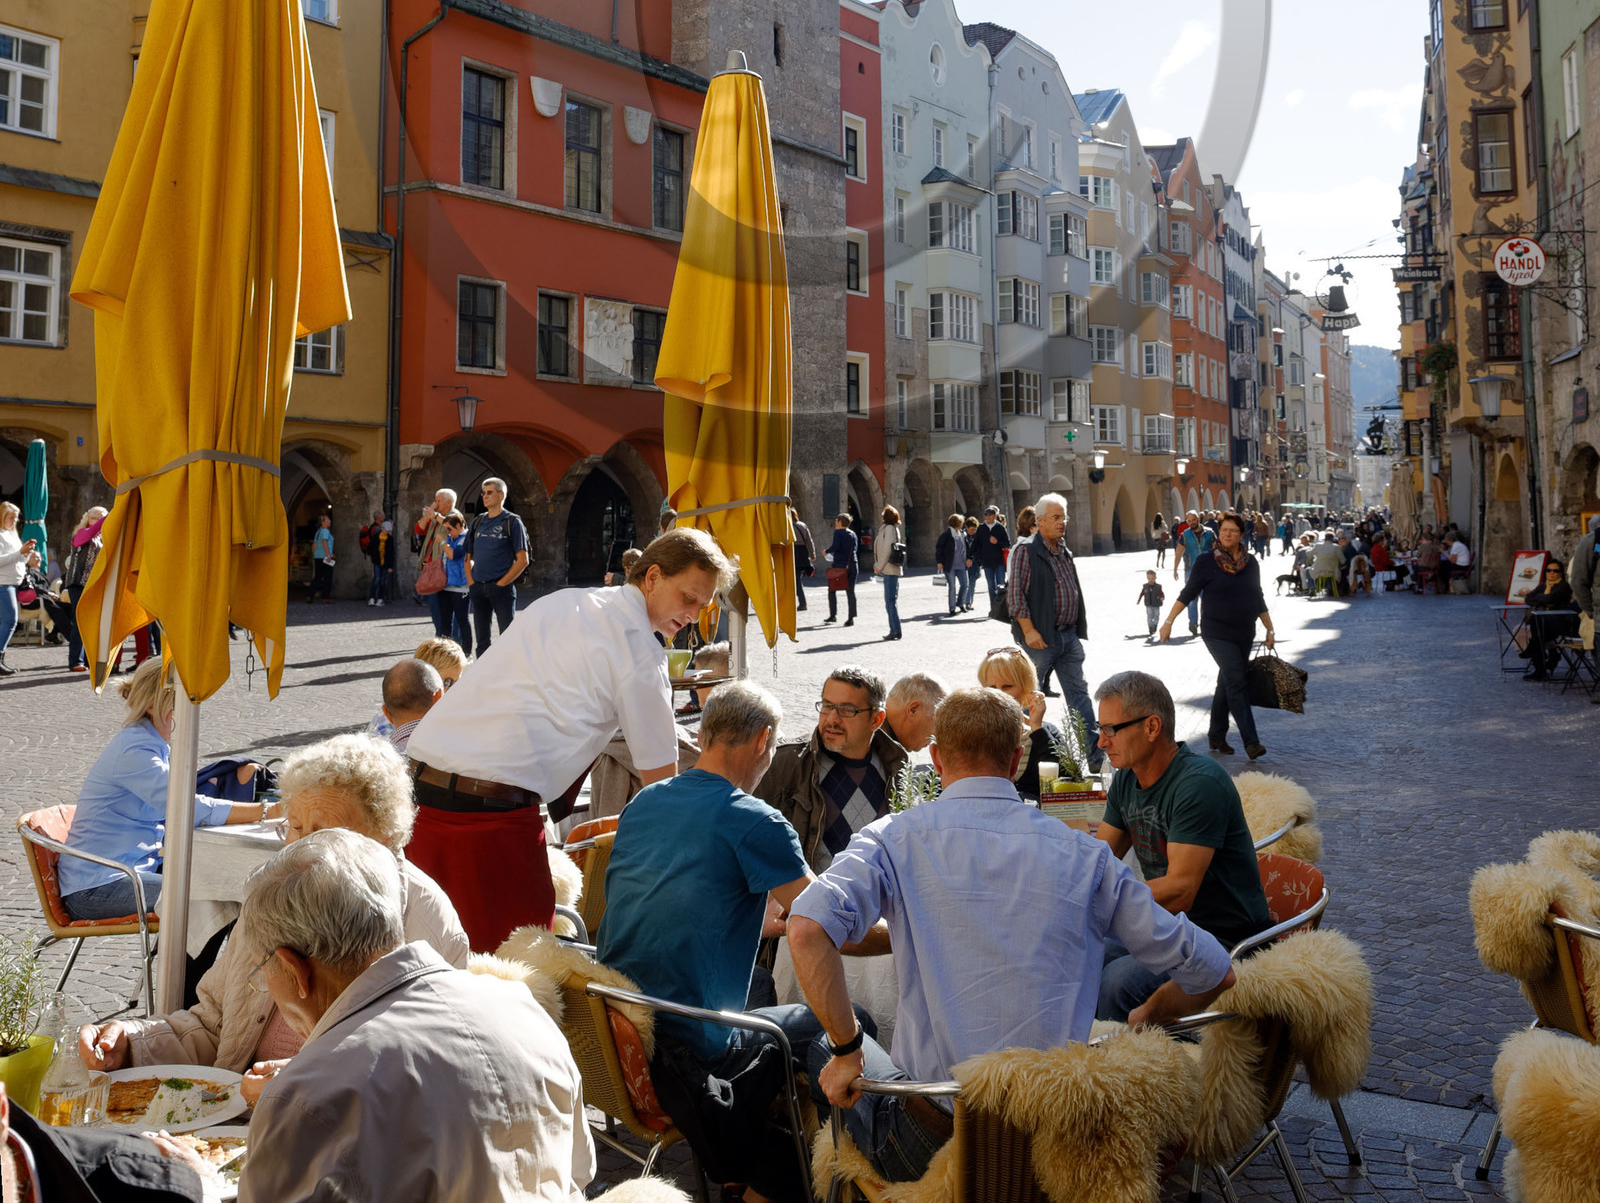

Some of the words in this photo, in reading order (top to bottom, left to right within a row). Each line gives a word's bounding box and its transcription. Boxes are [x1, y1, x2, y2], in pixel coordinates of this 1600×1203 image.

[1500, 255, 1541, 270] HANDL
[1396, 268, 1438, 278] Weinhaus
[1503, 267, 1534, 283] Tyrol
[1324, 316, 1357, 329] Happ
